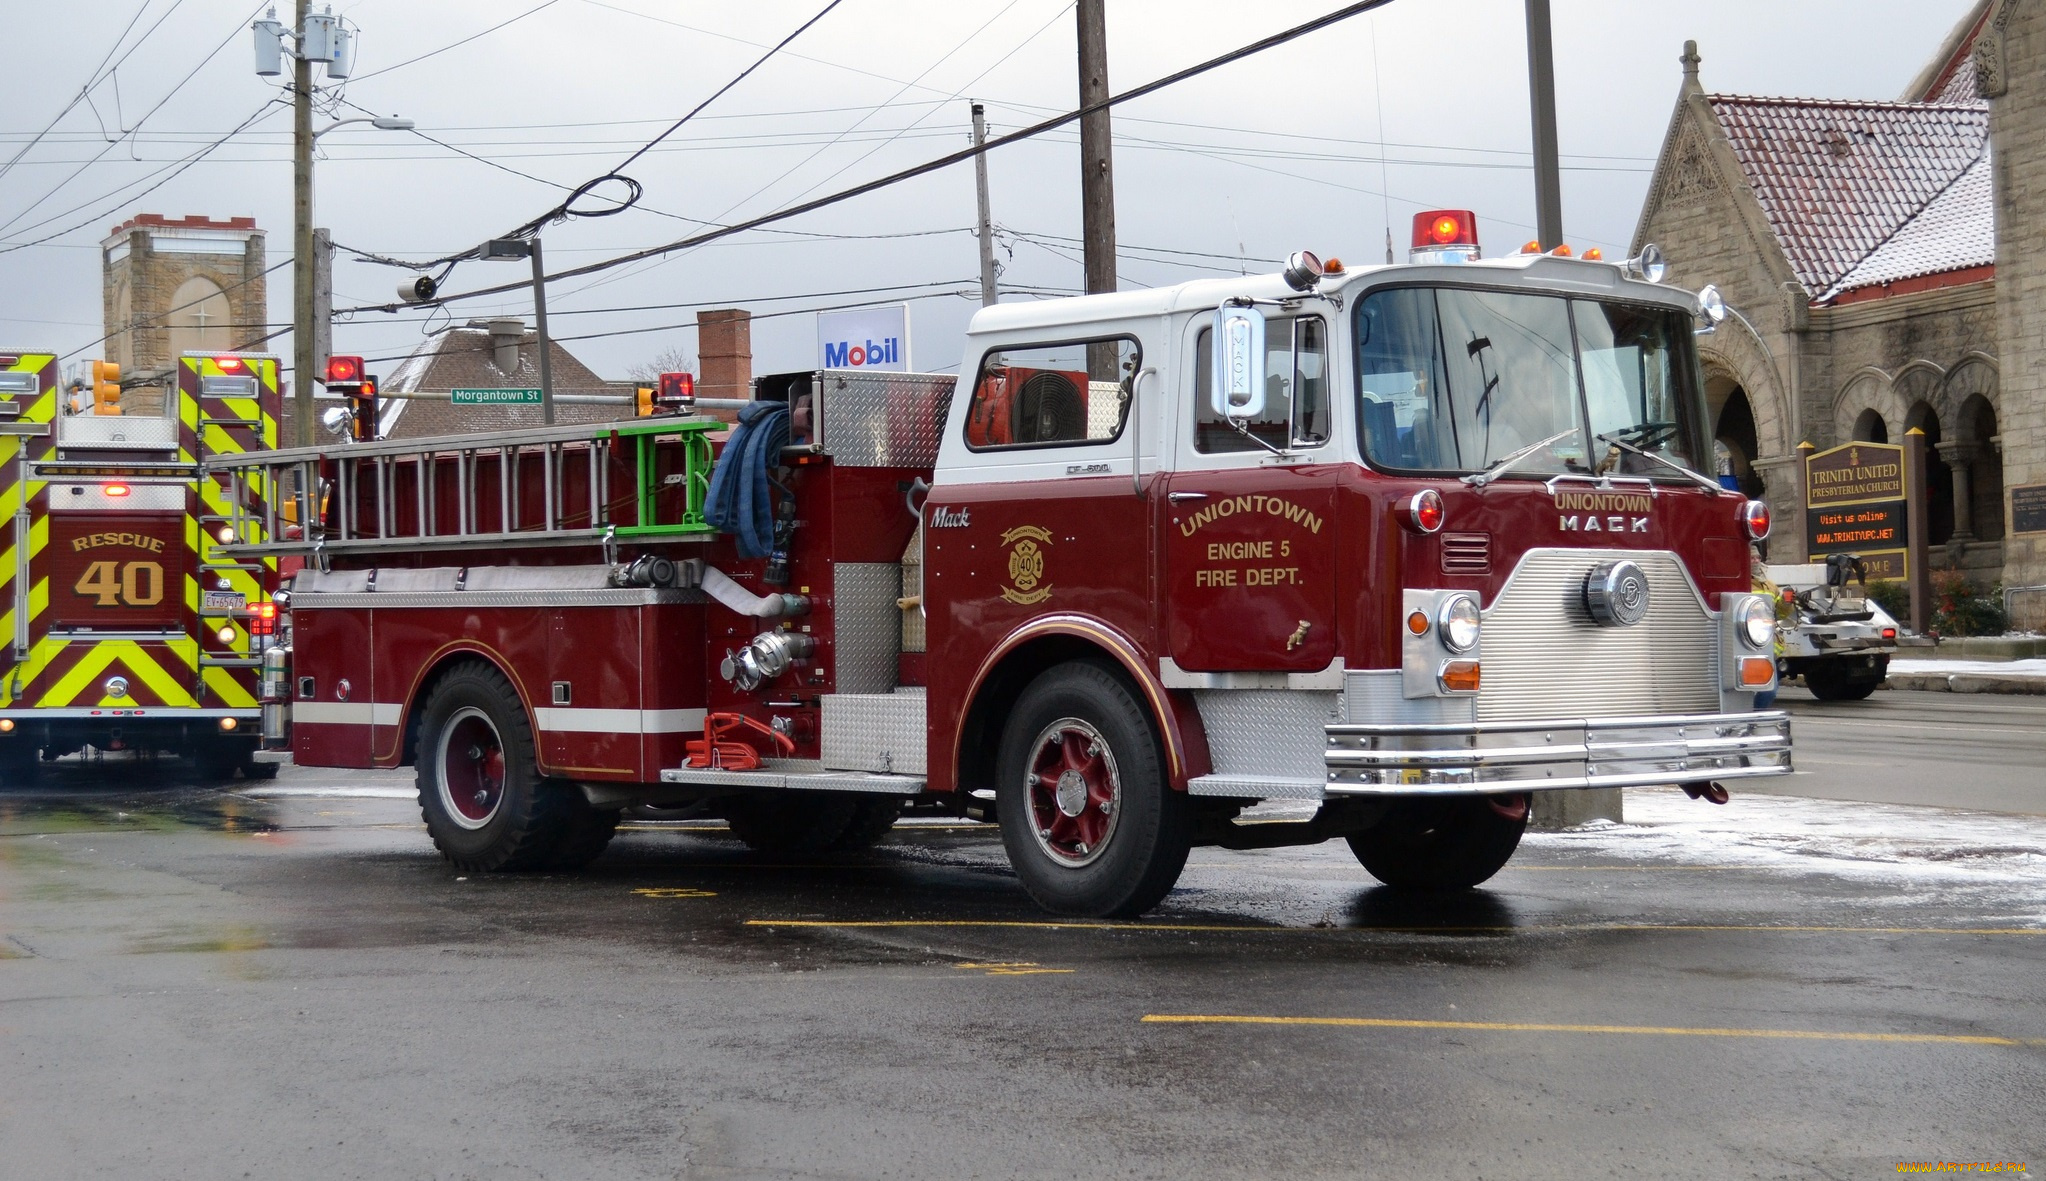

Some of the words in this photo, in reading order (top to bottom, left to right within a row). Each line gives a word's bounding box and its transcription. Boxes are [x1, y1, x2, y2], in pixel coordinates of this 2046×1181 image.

[825, 337, 898, 368] Mobil
[1233, 335, 1244, 388] MACK
[456, 390, 524, 402] Morgantown
[527, 390, 538, 400] St
[1812, 468, 1855, 484] TRINITY
[1856, 463, 1898, 480] UNITED
[1812, 484, 1865, 498] PRESBYTERIAN
[1866, 480, 1899, 493] CHURCH
[1554, 493, 1651, 512] UNIONTOWN
[930, 505, 971, 528] Mack
[1180, 495, 1323, 537] UNIONTOWN
[1559, 515, 1649, 533] MACK
[1820, 514, 1842, 525] Visit
[1844, 514, 1855, 523] us
[1857, 511, 1888, 522] online:
[72, 532, 166, 554] RESCUE
[1010, 528, 1043, 539] UNIONTOWN
[1816, 528, 1894, 544] WWW.TRINITYUPC.NET
[1207, 541, 1273, 560] ENGINE
[1280, 540, 1290, 557] 5
[1020, 557, 1032, 572] 40
[73, 561, 164, 607] 40
[1196, 569, 1237, 588] FIRE
[1246, 567, 1304, 586] DEPT.
[1010, 592, 1023, 601] FIRE
